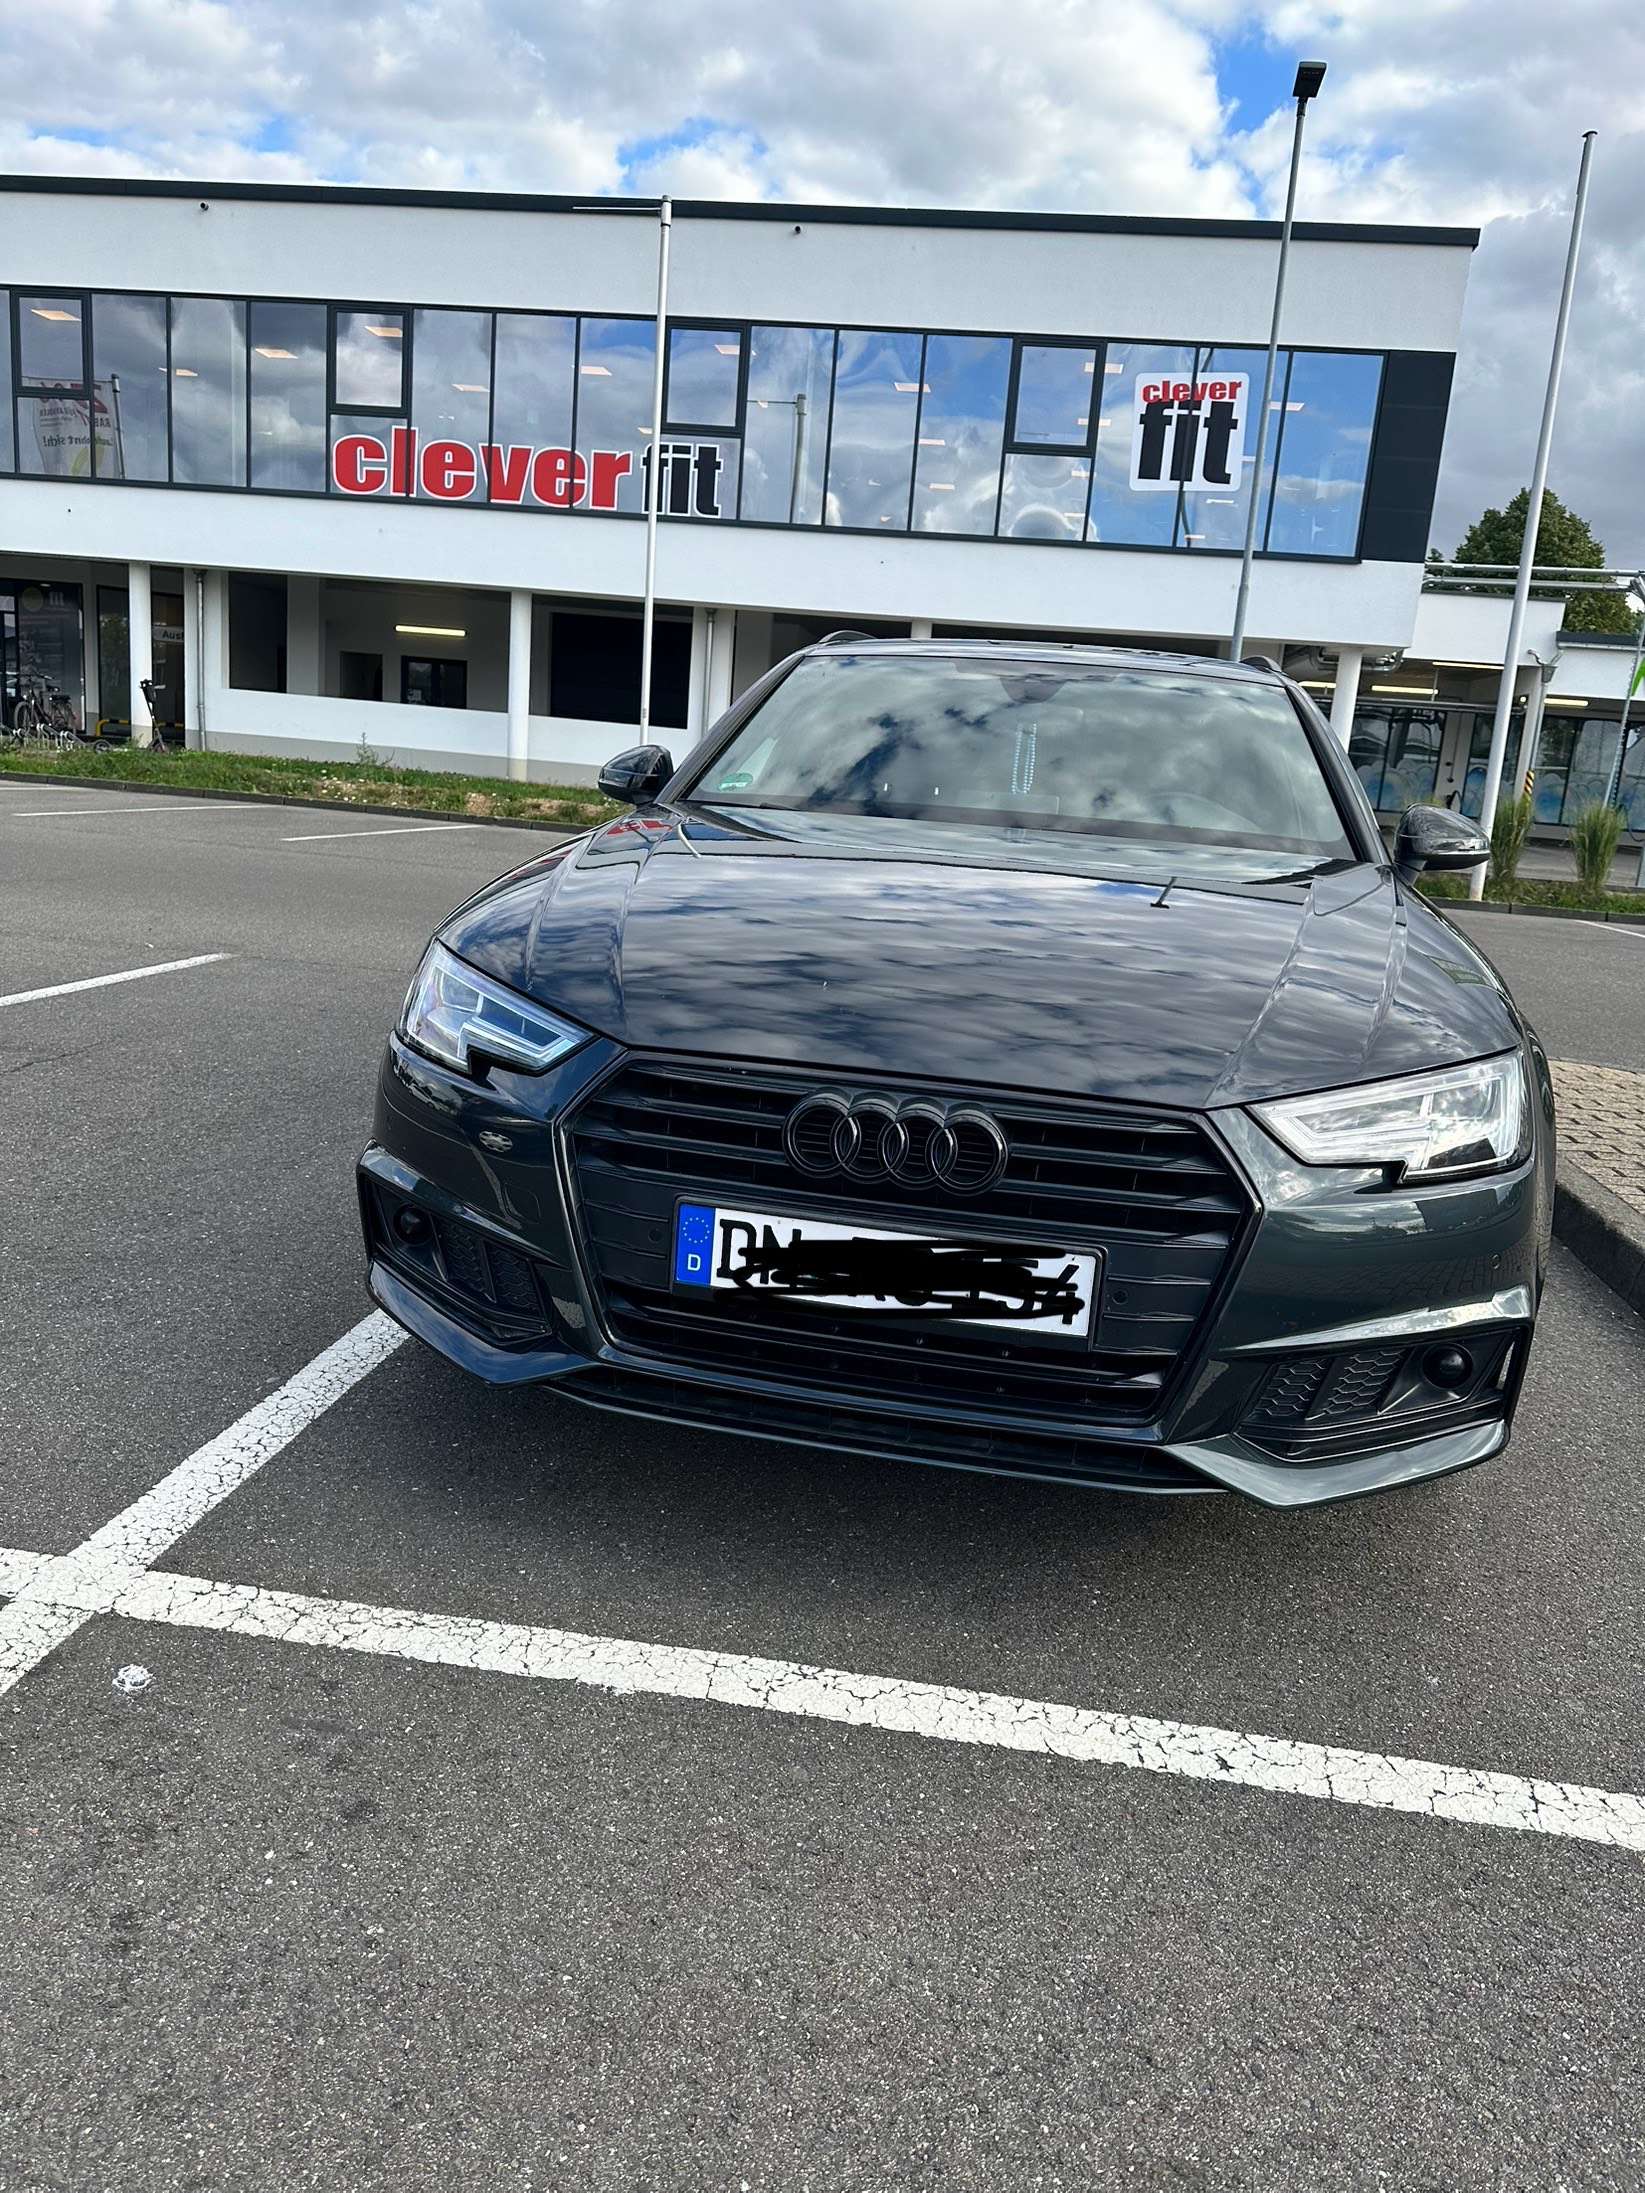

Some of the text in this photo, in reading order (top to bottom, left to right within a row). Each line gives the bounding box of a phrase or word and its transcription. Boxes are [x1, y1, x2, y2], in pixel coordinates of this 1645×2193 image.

[1142, 380, 1242, 404] clever
[1138, 400, 1239, 485] fit
[333, 426, 723, 518] clever fit
[687, 1253, 702, 1272] D
